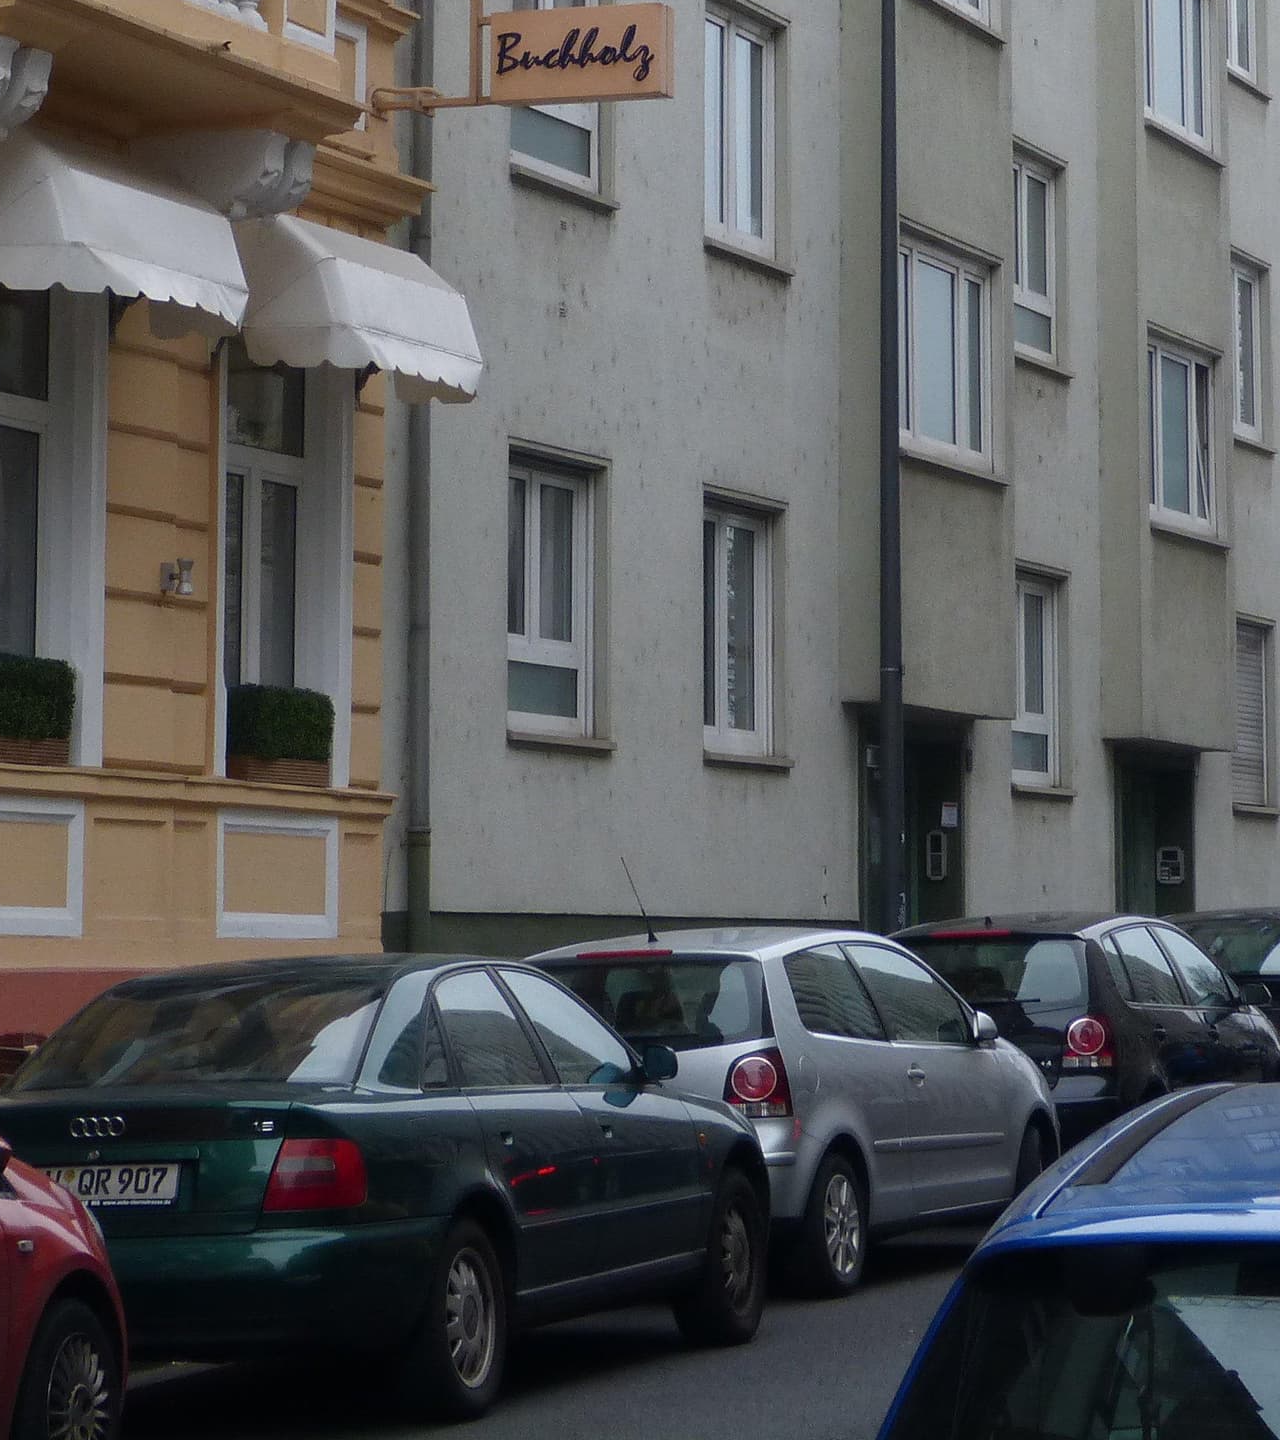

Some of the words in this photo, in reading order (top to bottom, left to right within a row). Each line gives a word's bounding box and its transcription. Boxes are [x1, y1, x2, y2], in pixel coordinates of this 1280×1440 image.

[496, 24, 654, 81] Buchholz
[77, 1168, 112, 1195] QR
[118, 1167, 168, 1194] 907
